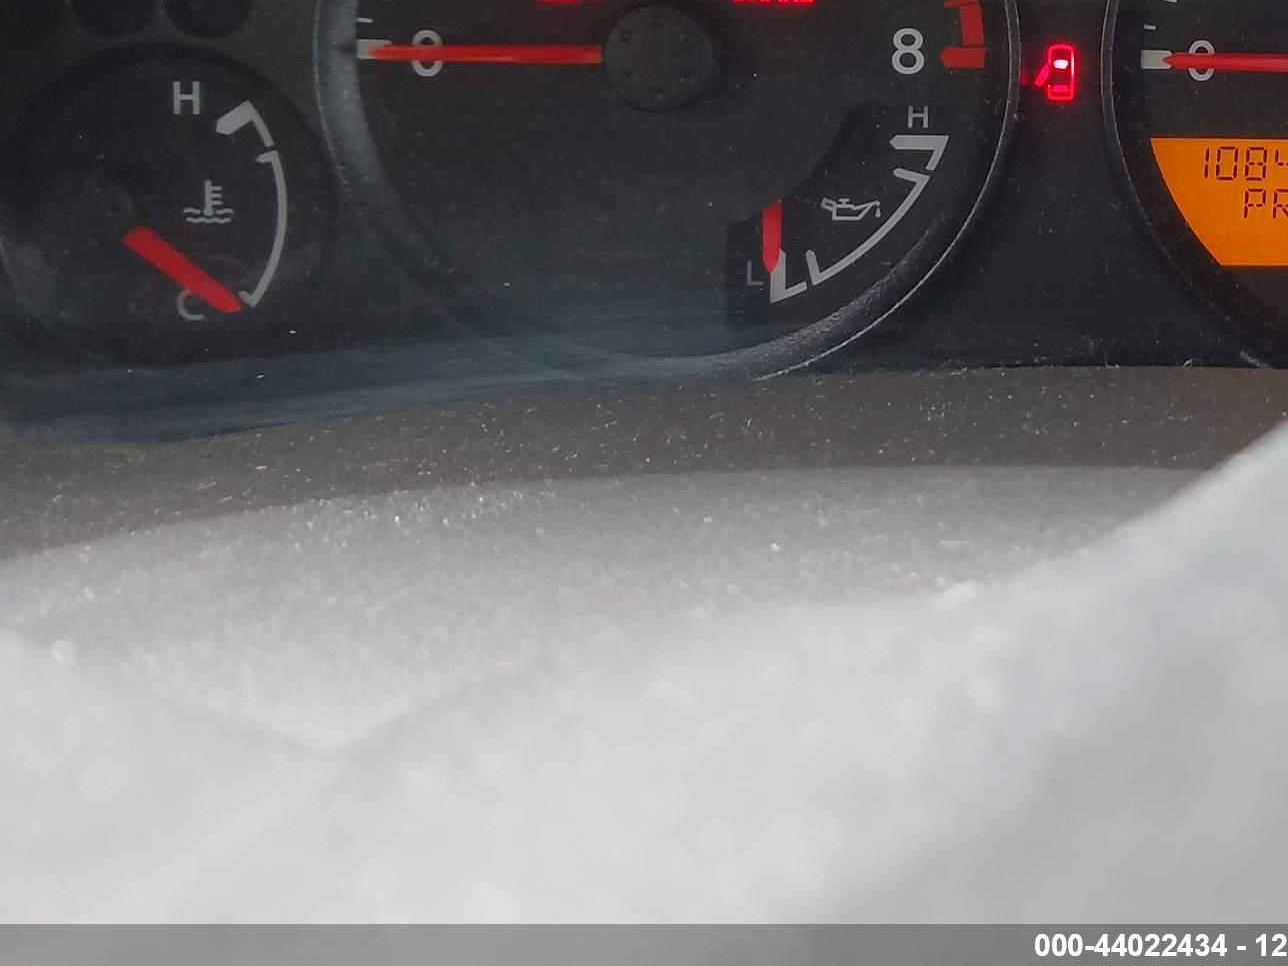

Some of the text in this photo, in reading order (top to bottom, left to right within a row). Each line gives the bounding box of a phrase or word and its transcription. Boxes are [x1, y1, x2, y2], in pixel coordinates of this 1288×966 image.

[891, 28, 926, 75] 8
[173, 82, 201, 115] H
[907, 106, 929, 129] H
[746, 260, 764, 286] L
